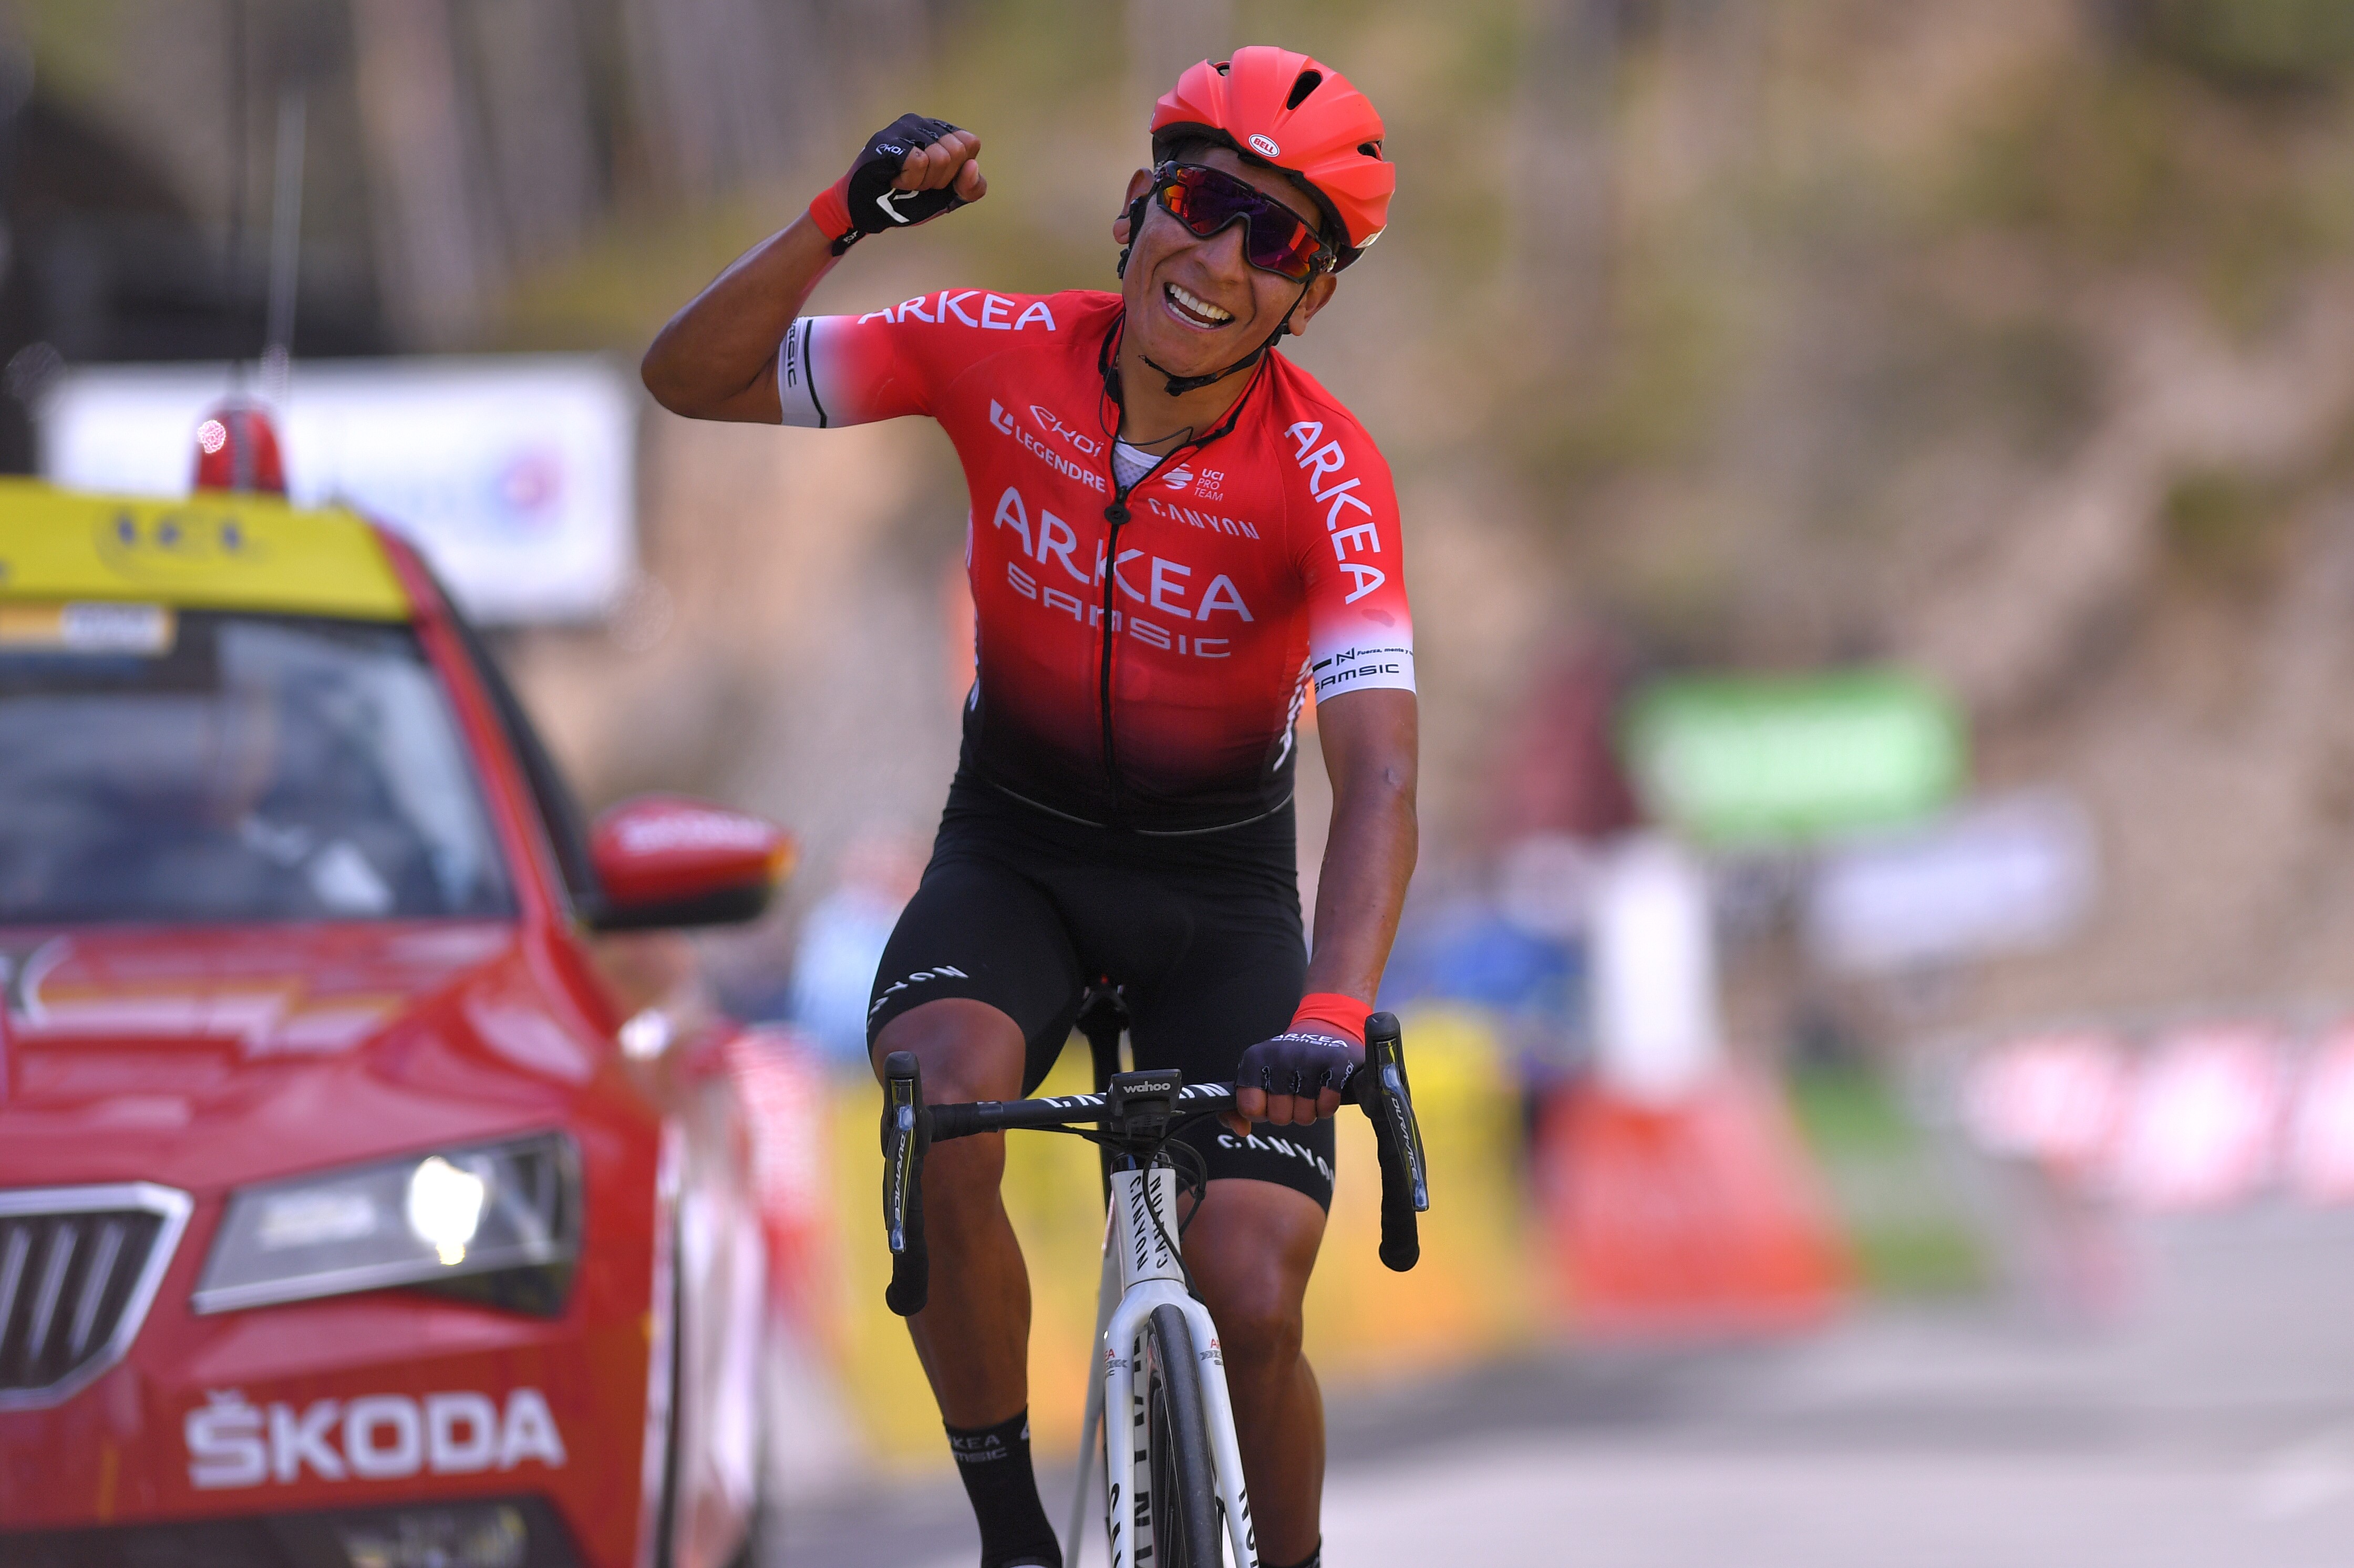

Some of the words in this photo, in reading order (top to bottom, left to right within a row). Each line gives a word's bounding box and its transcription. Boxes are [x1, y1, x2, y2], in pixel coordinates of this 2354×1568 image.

[1253, 137, 1274, 153] BELL
[856, 290, 1056, 331] ARKEA
[1015, 426, 1106, 492] LEGENDRE
[1196, 478, 1220, 490] PRO
[1202, 468, 1224, 481] UCI
[1194, 487, 1224, 501] TEAM
[1284, 421, 1386, 605] ARKEA
[993, 486, 1255, 622] ARKEA
[1008, 561, 1231, 658] SAMSIC
[1273, 1033, 1348, 1048] ARKEA
[1123, 1081, 1171, 1094] wahoo
[1391, 1098, 1418, 1181] DURA-ACE
[895, 1132, 906, 1222] DURA-ACE
[1130, 1175, 1149, 1272] CANYON
[185, 1390, 566, 1489] ŠKODA
